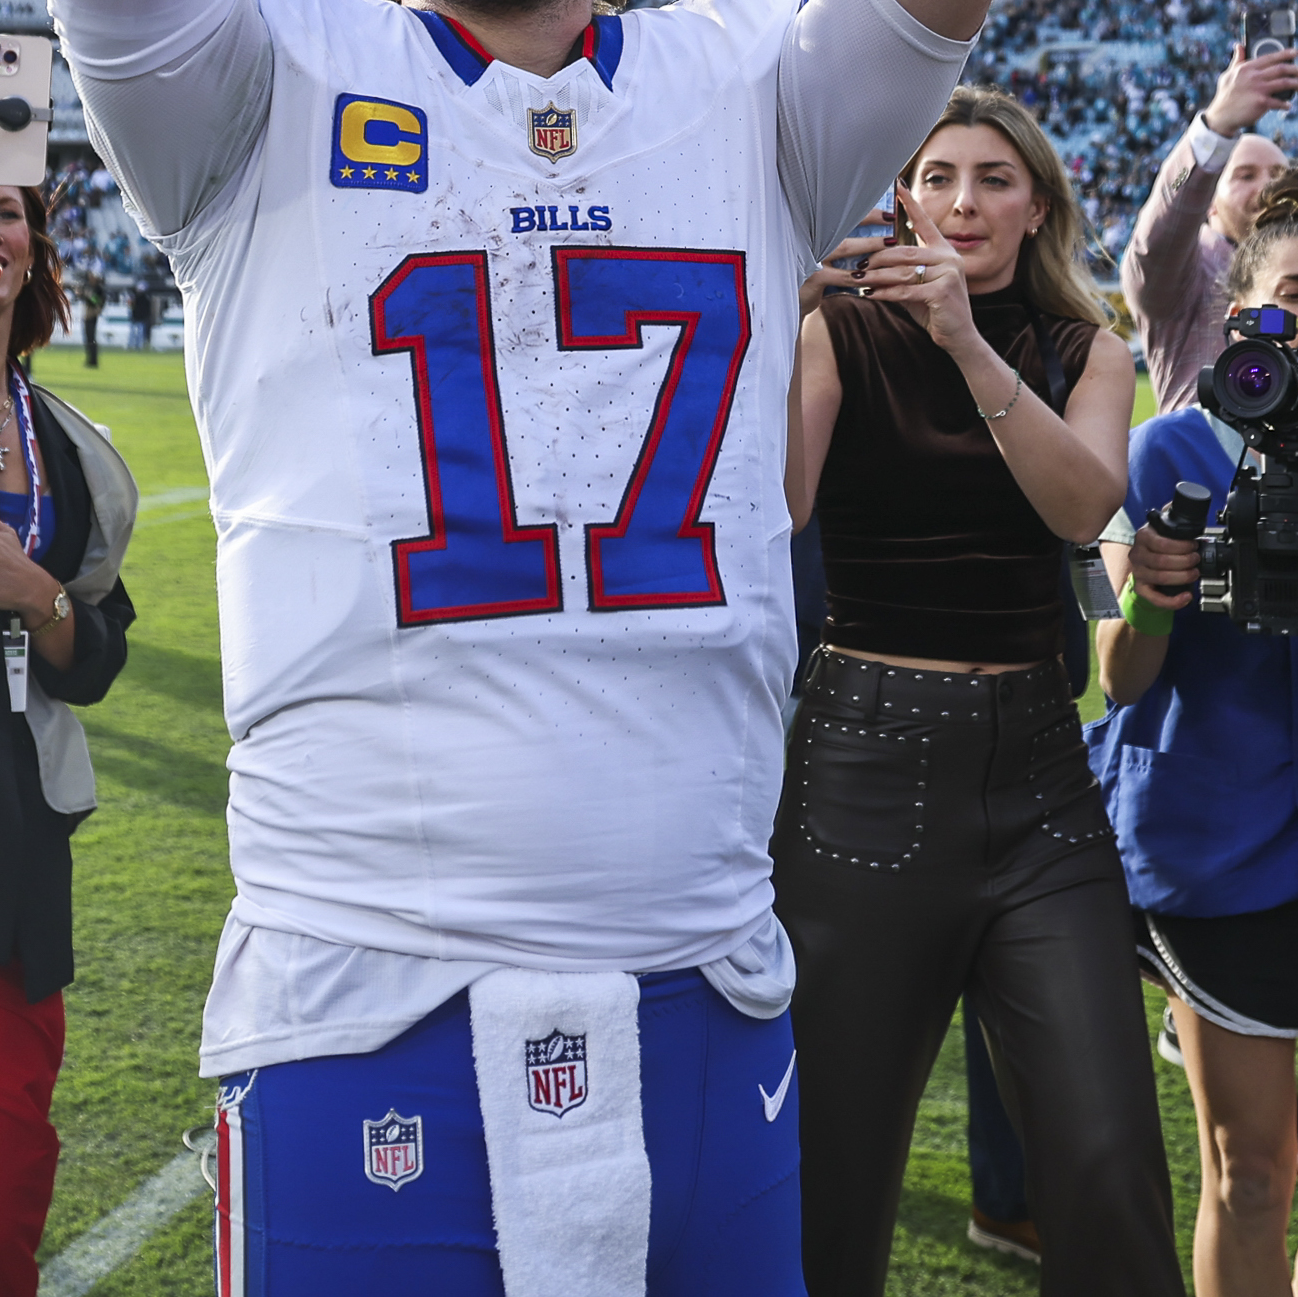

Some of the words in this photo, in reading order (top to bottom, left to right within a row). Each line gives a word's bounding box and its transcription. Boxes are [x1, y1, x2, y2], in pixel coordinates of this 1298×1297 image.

[339, 100, 422, 167] C
[534, 127, 570, 152] NFL
[510, 205, 612, 234] BILLS
[367, 245, 752, 629] 17
[532, 1064, 583, 1109] NFL
[374, 1145, 415, 1177] NFL
